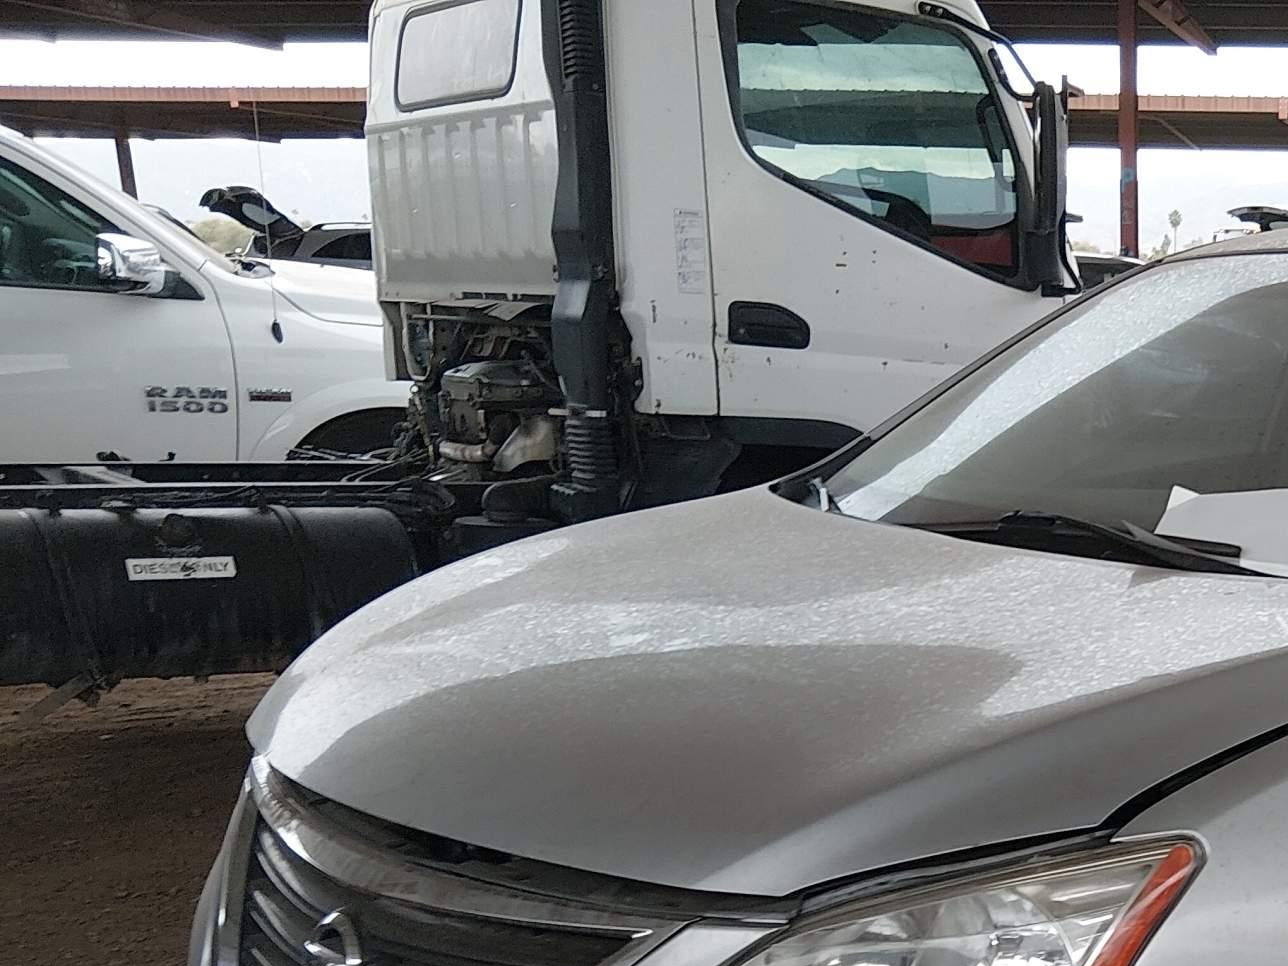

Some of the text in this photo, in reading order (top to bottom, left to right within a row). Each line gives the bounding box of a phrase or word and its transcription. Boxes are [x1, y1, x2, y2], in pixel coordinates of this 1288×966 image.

[145, 386, 228, 399] RAM
[147, 400, 229, 413] 1500
[132, 561, 189, 575] DIESE
